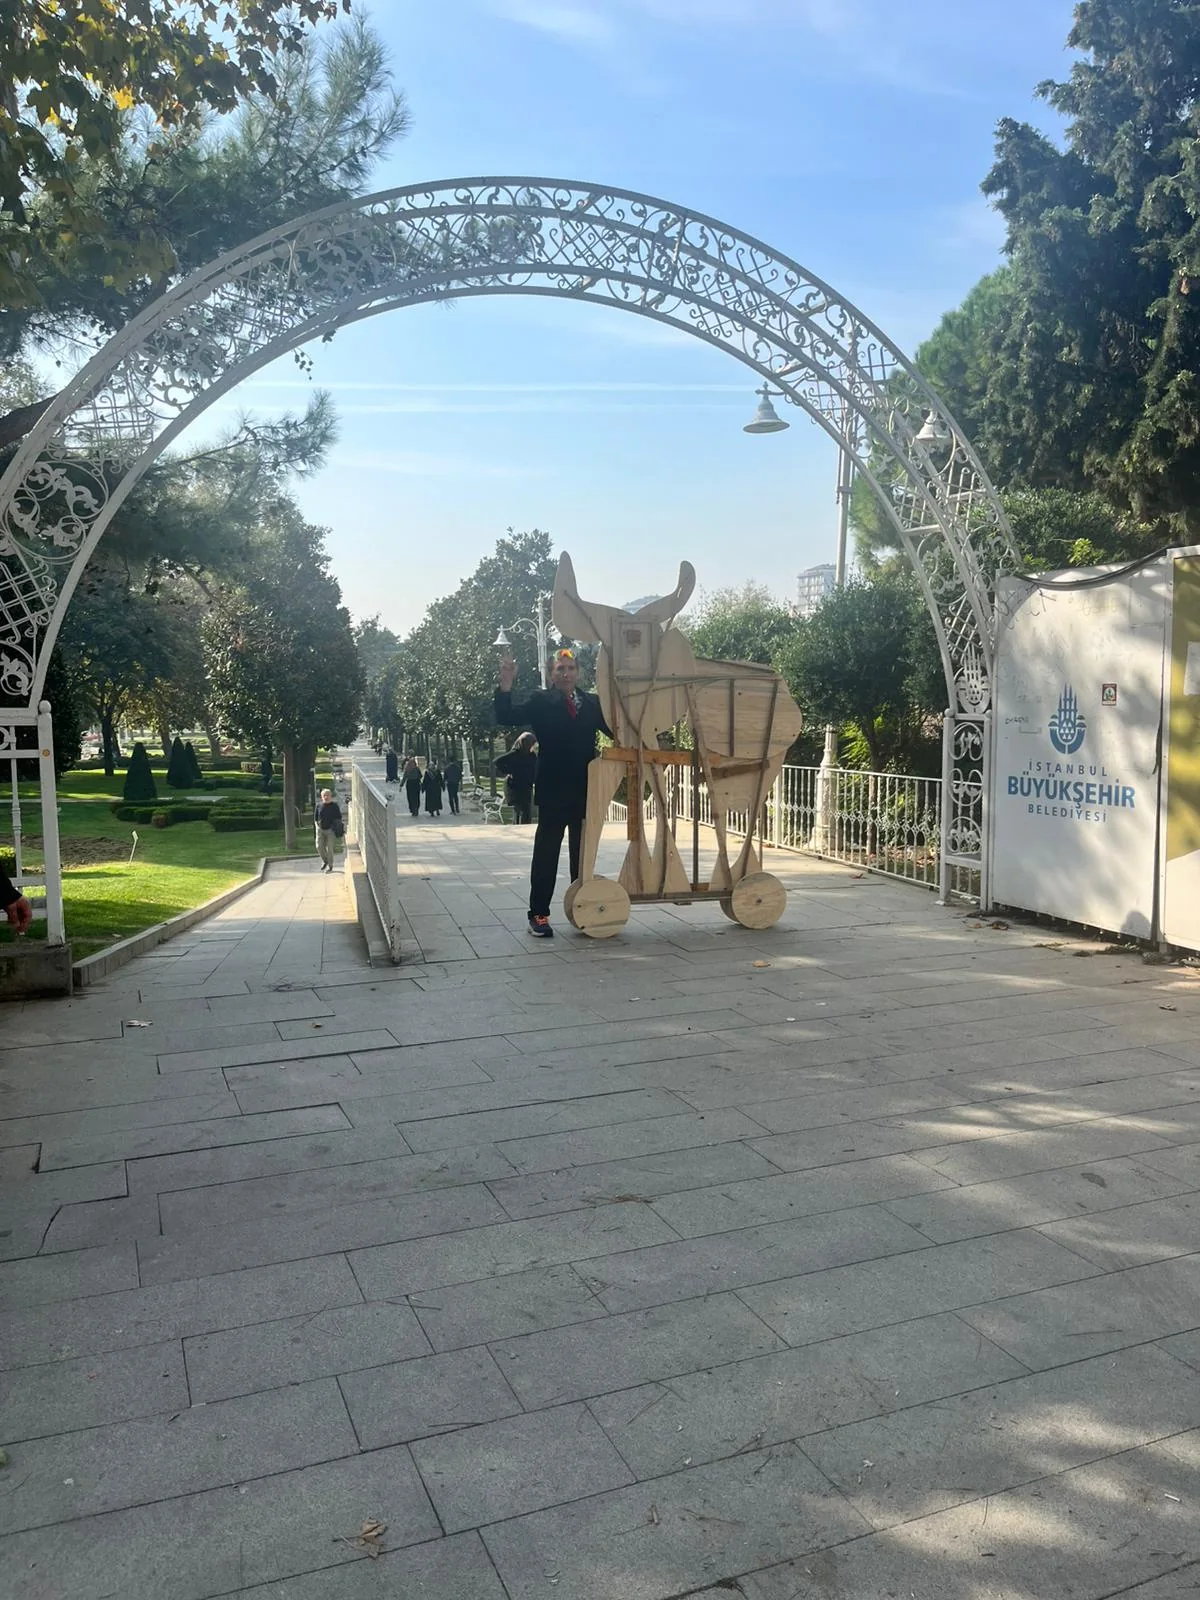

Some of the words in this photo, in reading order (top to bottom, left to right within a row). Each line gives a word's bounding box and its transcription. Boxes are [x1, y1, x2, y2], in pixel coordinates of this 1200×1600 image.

[1028, 759, 1108, 777] İSTANBUL
[1007, 770, 1136, 809] BÜYÜKŞEHİR
[1028, 803, 1107, 823] BELEDİYESİ
